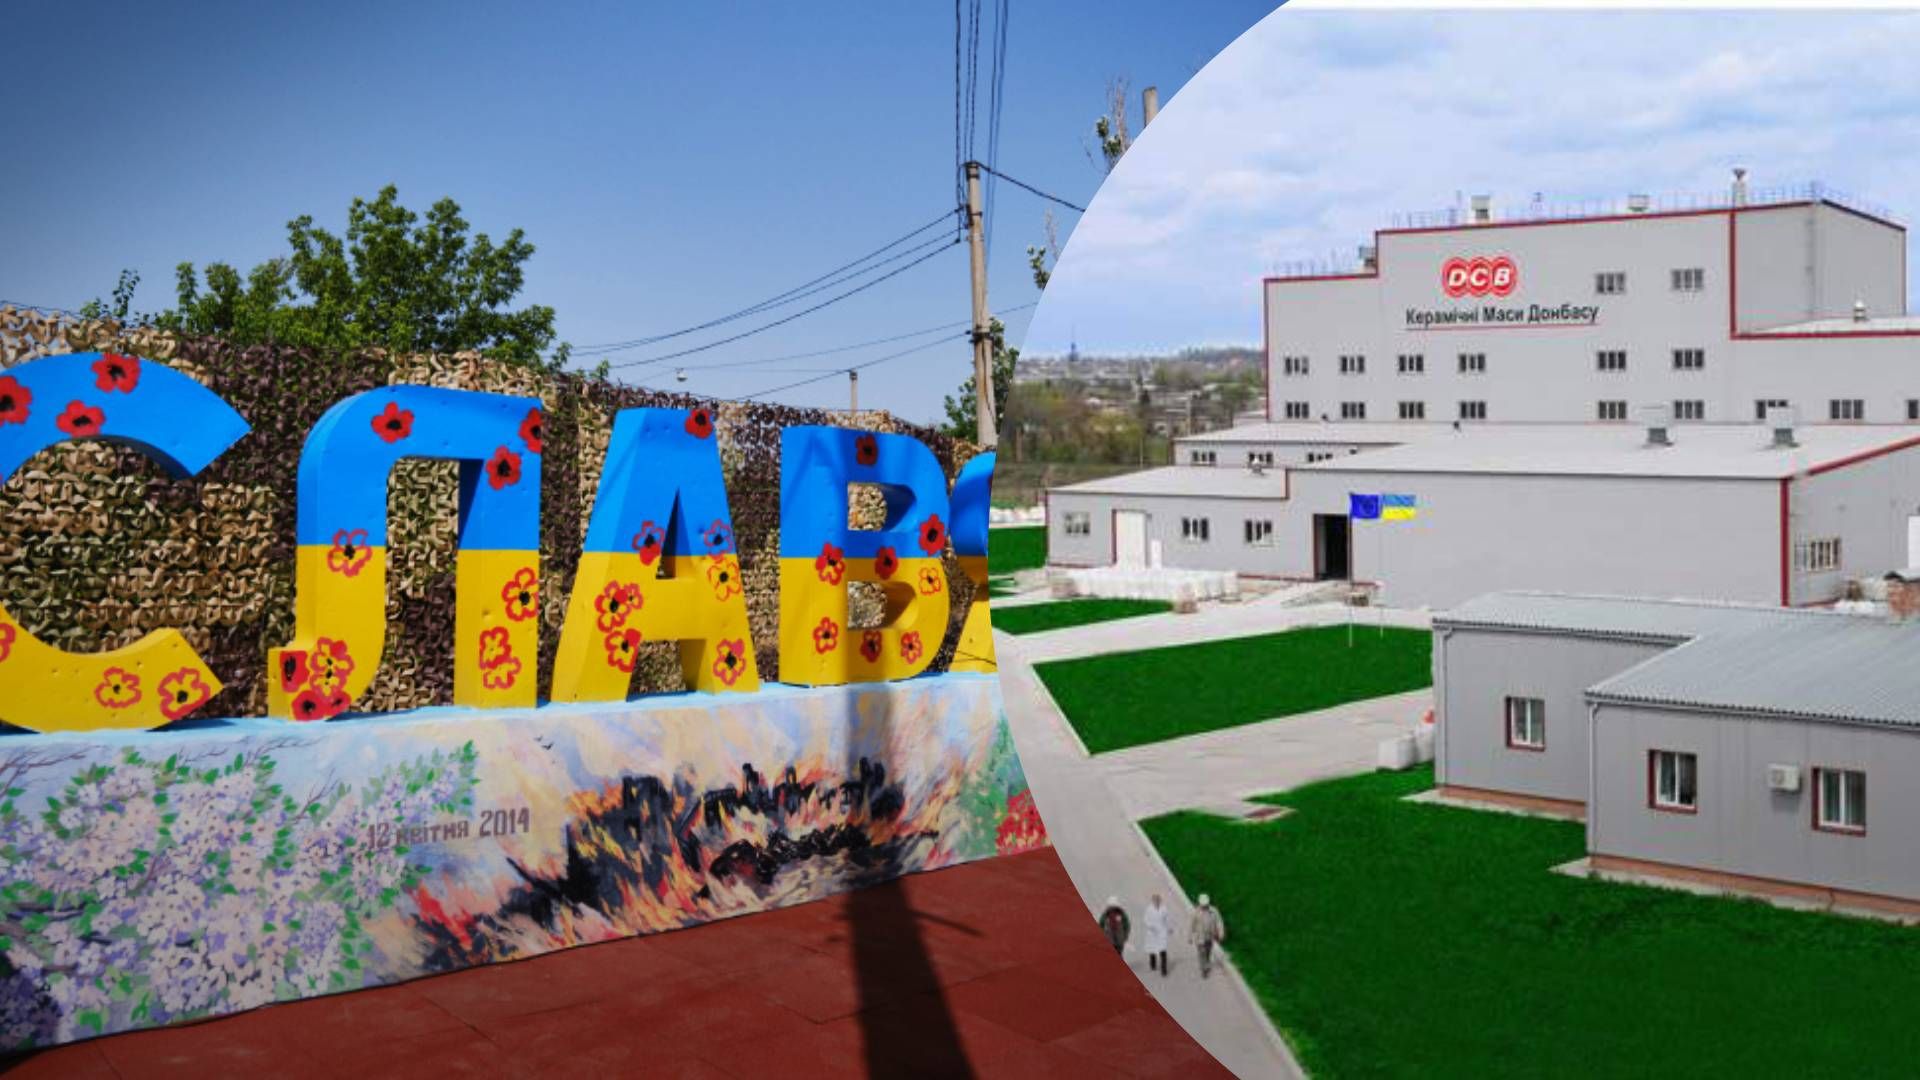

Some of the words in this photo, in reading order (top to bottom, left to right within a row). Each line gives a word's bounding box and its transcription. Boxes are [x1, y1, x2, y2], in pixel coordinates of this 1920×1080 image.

[1448, 267, 1511, 287] DCB
[1406, 307, 1479, 330] Керамічні
[1482, 305, 1524, 323] Маси
[1527, 303, 1599, 325] Донбасу
[367, 822, 390, 849] 12
[396, 820, 469, 845] квітня
[479, 807, 530, 838] 2014
